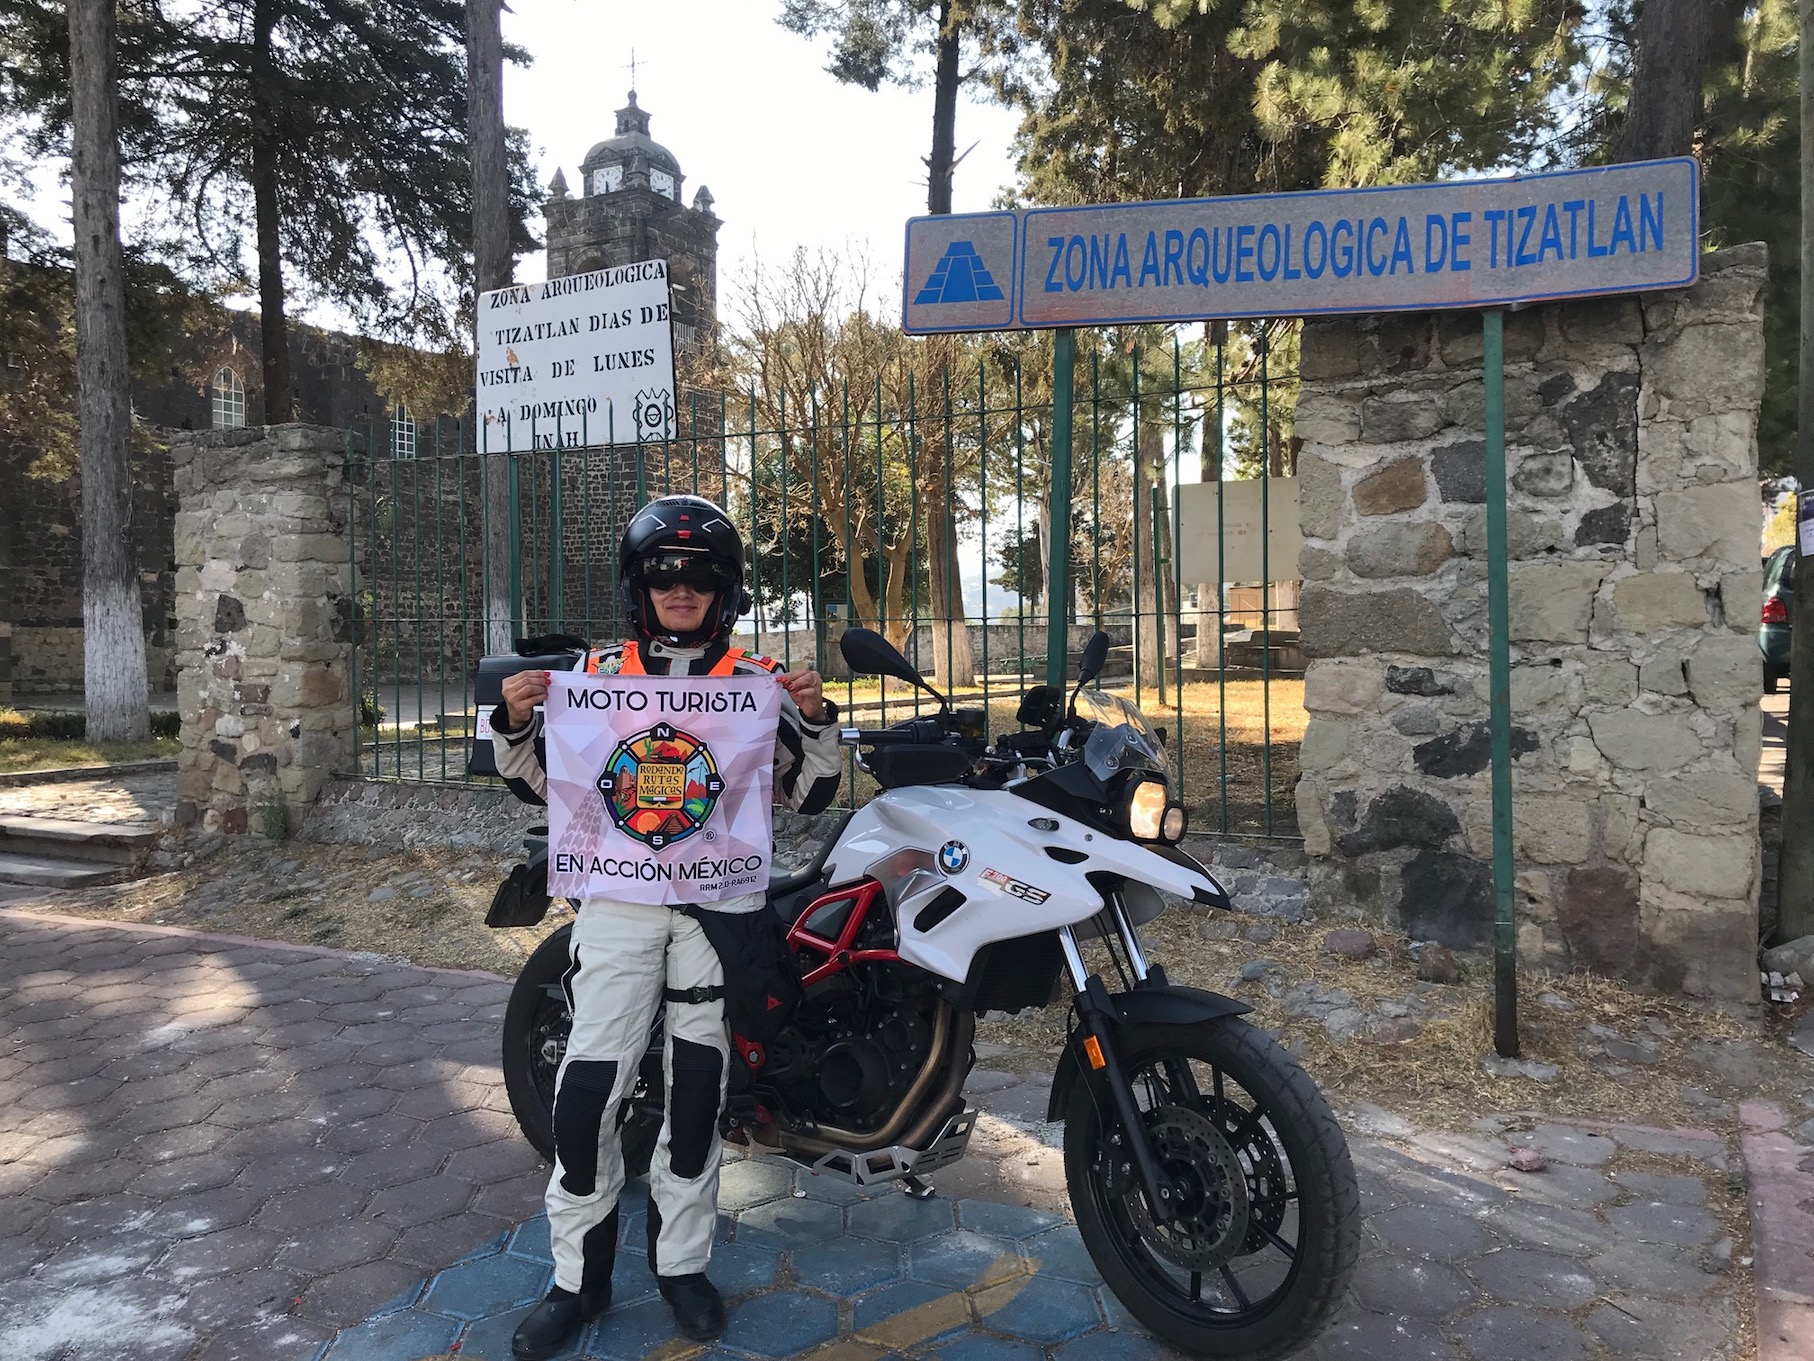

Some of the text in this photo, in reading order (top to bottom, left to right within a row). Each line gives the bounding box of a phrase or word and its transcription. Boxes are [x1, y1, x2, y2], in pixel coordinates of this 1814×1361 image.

[1045, 191, 1664, 293] ZONA ARQUEOLOGICA DE TIZATLAN
[490, 261, 666, 309] ZONA ARQUEOLOGICA
[495, 303, 669, 346] TIZATLAN DIAS DE
[480, 349, 655, 387] VISITA DE LUNES
[497, 398, 597, 423] A DOMINGO
[534, 431, 579, 450] INAH
[567, 688, 757, 713] MOTO TURISTA
[656, 727, 670, 738] N
[709, 781, 720, 791] E
[652, 835, 664, 846] S
[556, 853, 763, 882] EN ACCIÓN MÉXICO
[1005, 881, 1047, 904] GS
